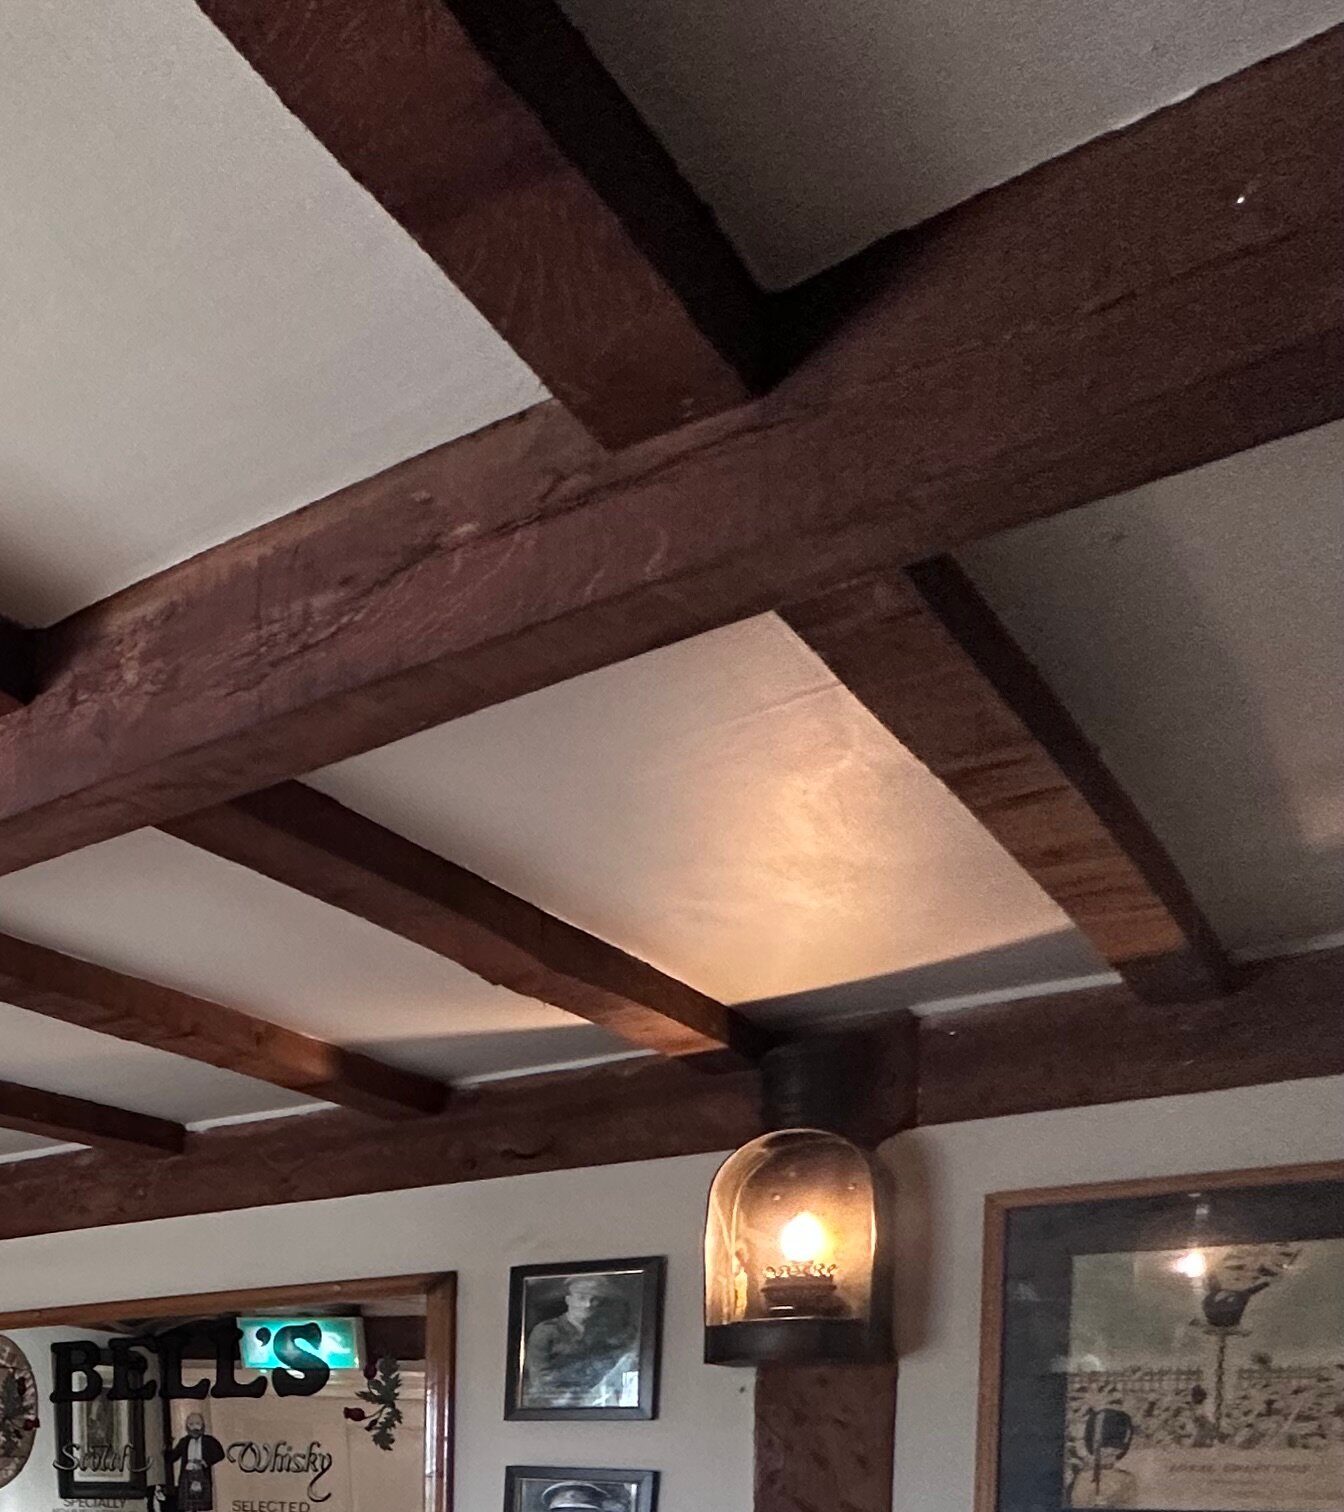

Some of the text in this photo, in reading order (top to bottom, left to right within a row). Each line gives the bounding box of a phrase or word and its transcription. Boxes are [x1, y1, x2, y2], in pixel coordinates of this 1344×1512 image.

[49, 1318, 332, 1404] BELL'S
[63, 1497, 127, 1508] SPECIALLY
[225, 1440, 333, 1503] Whisky
